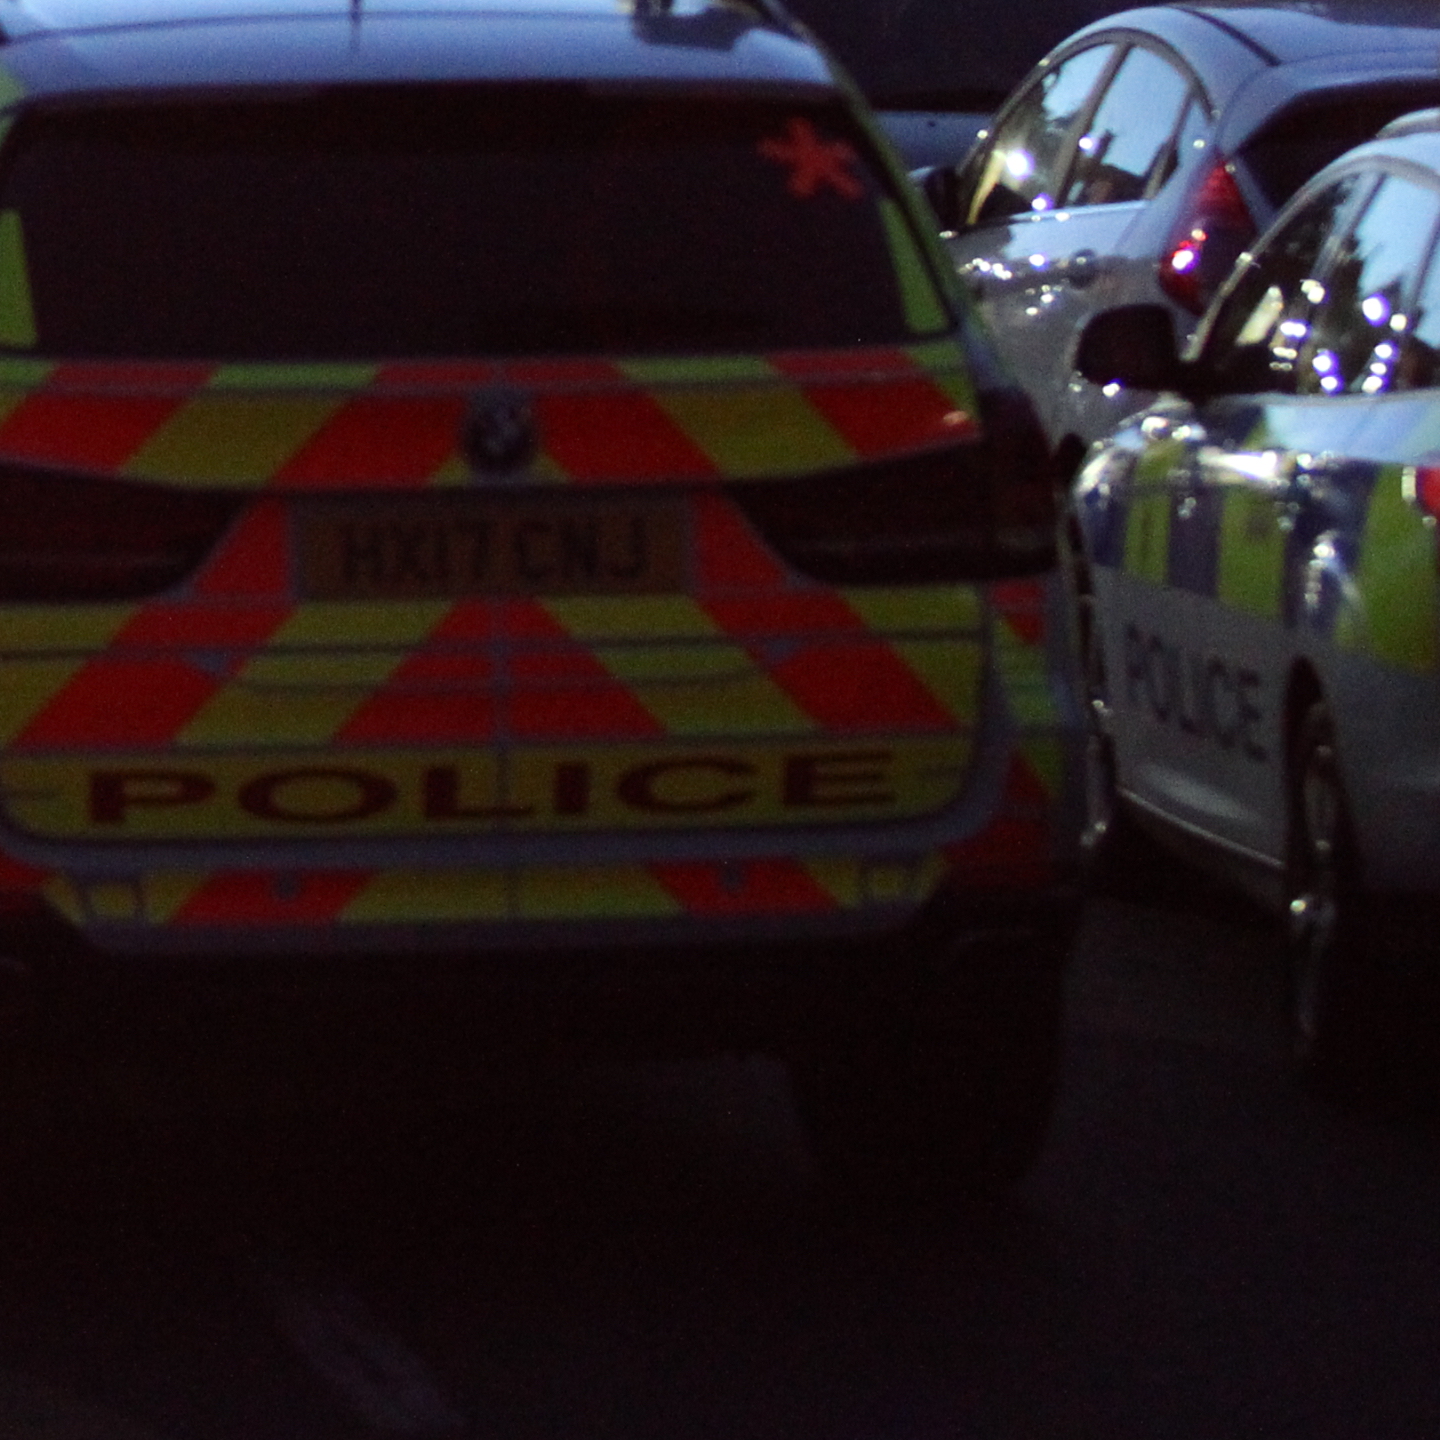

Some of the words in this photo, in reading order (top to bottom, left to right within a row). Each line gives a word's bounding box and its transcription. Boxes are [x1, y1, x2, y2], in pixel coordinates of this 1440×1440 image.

[341, 516, 493, 584] HX17
[515, 516, 648, 580] CNJ
[1125, 622, 1268, 763] POLICE
[88, 750, 898, 824] POLICE
